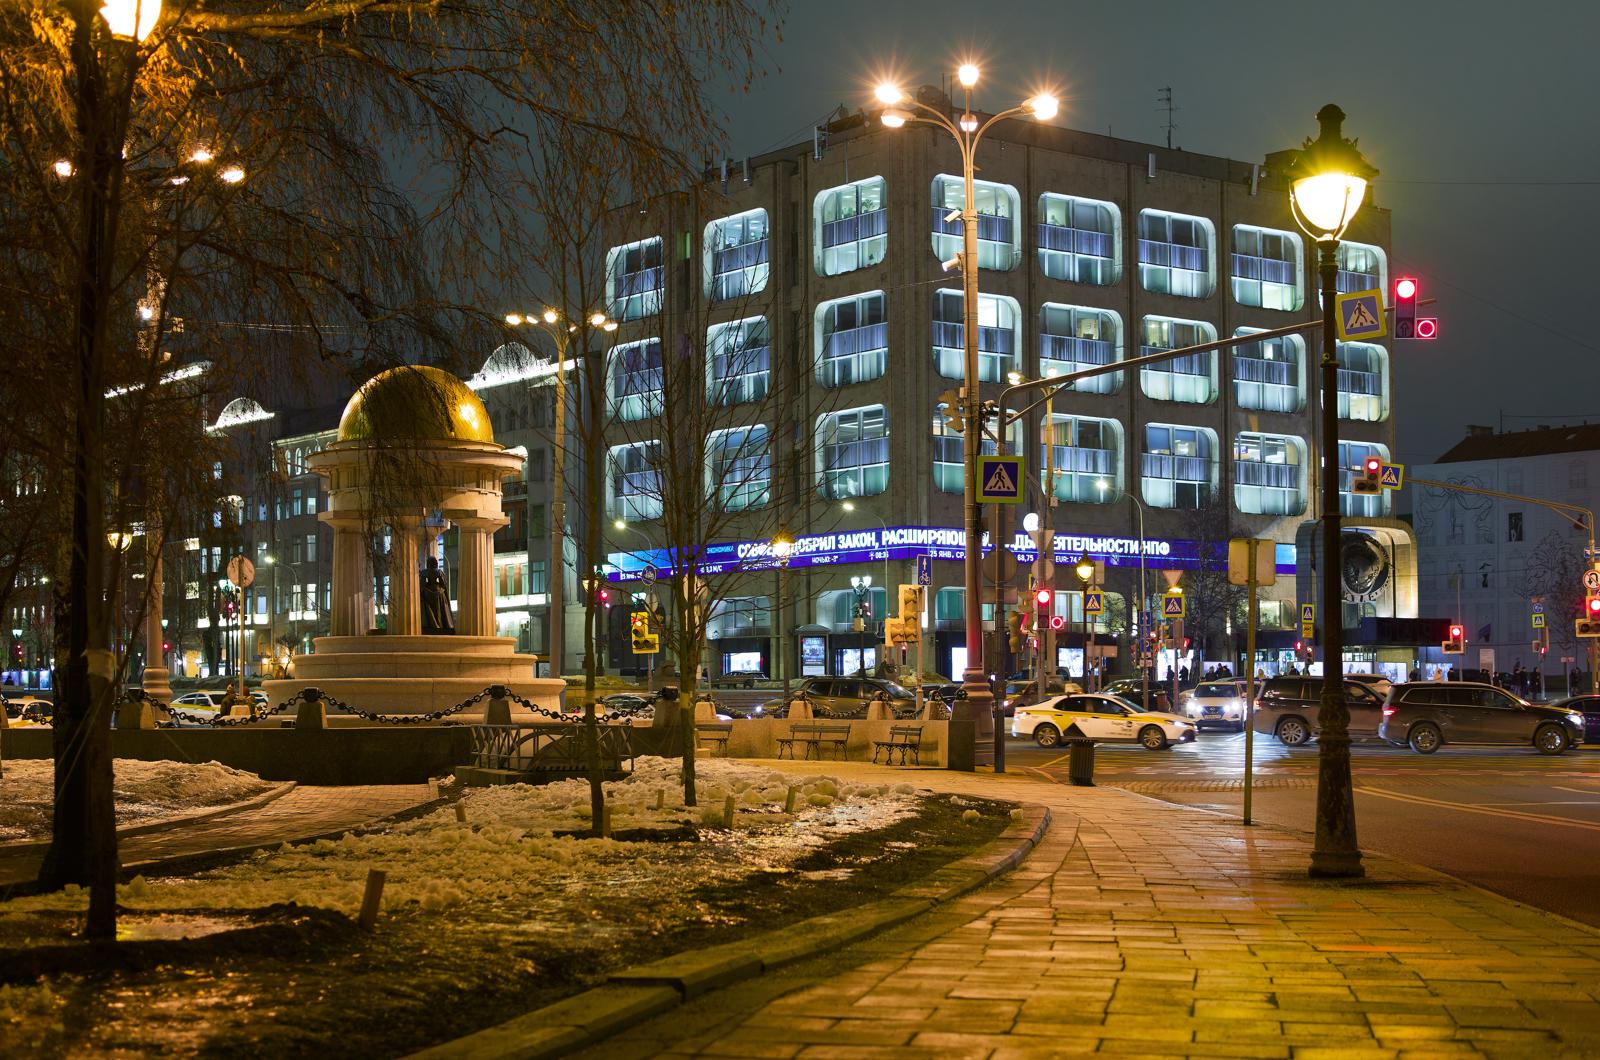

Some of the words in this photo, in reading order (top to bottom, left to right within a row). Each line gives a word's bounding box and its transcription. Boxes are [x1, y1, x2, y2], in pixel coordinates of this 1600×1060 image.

[788, 535, 836, 555] ДОБРИЛ
[839, 532, 879, 549] ЗАКОН,
[1142, 540, 1170, 555] НПФ
[930, 550, 938, 558] 25
[1017, 554, 1034, 562] 68,75
